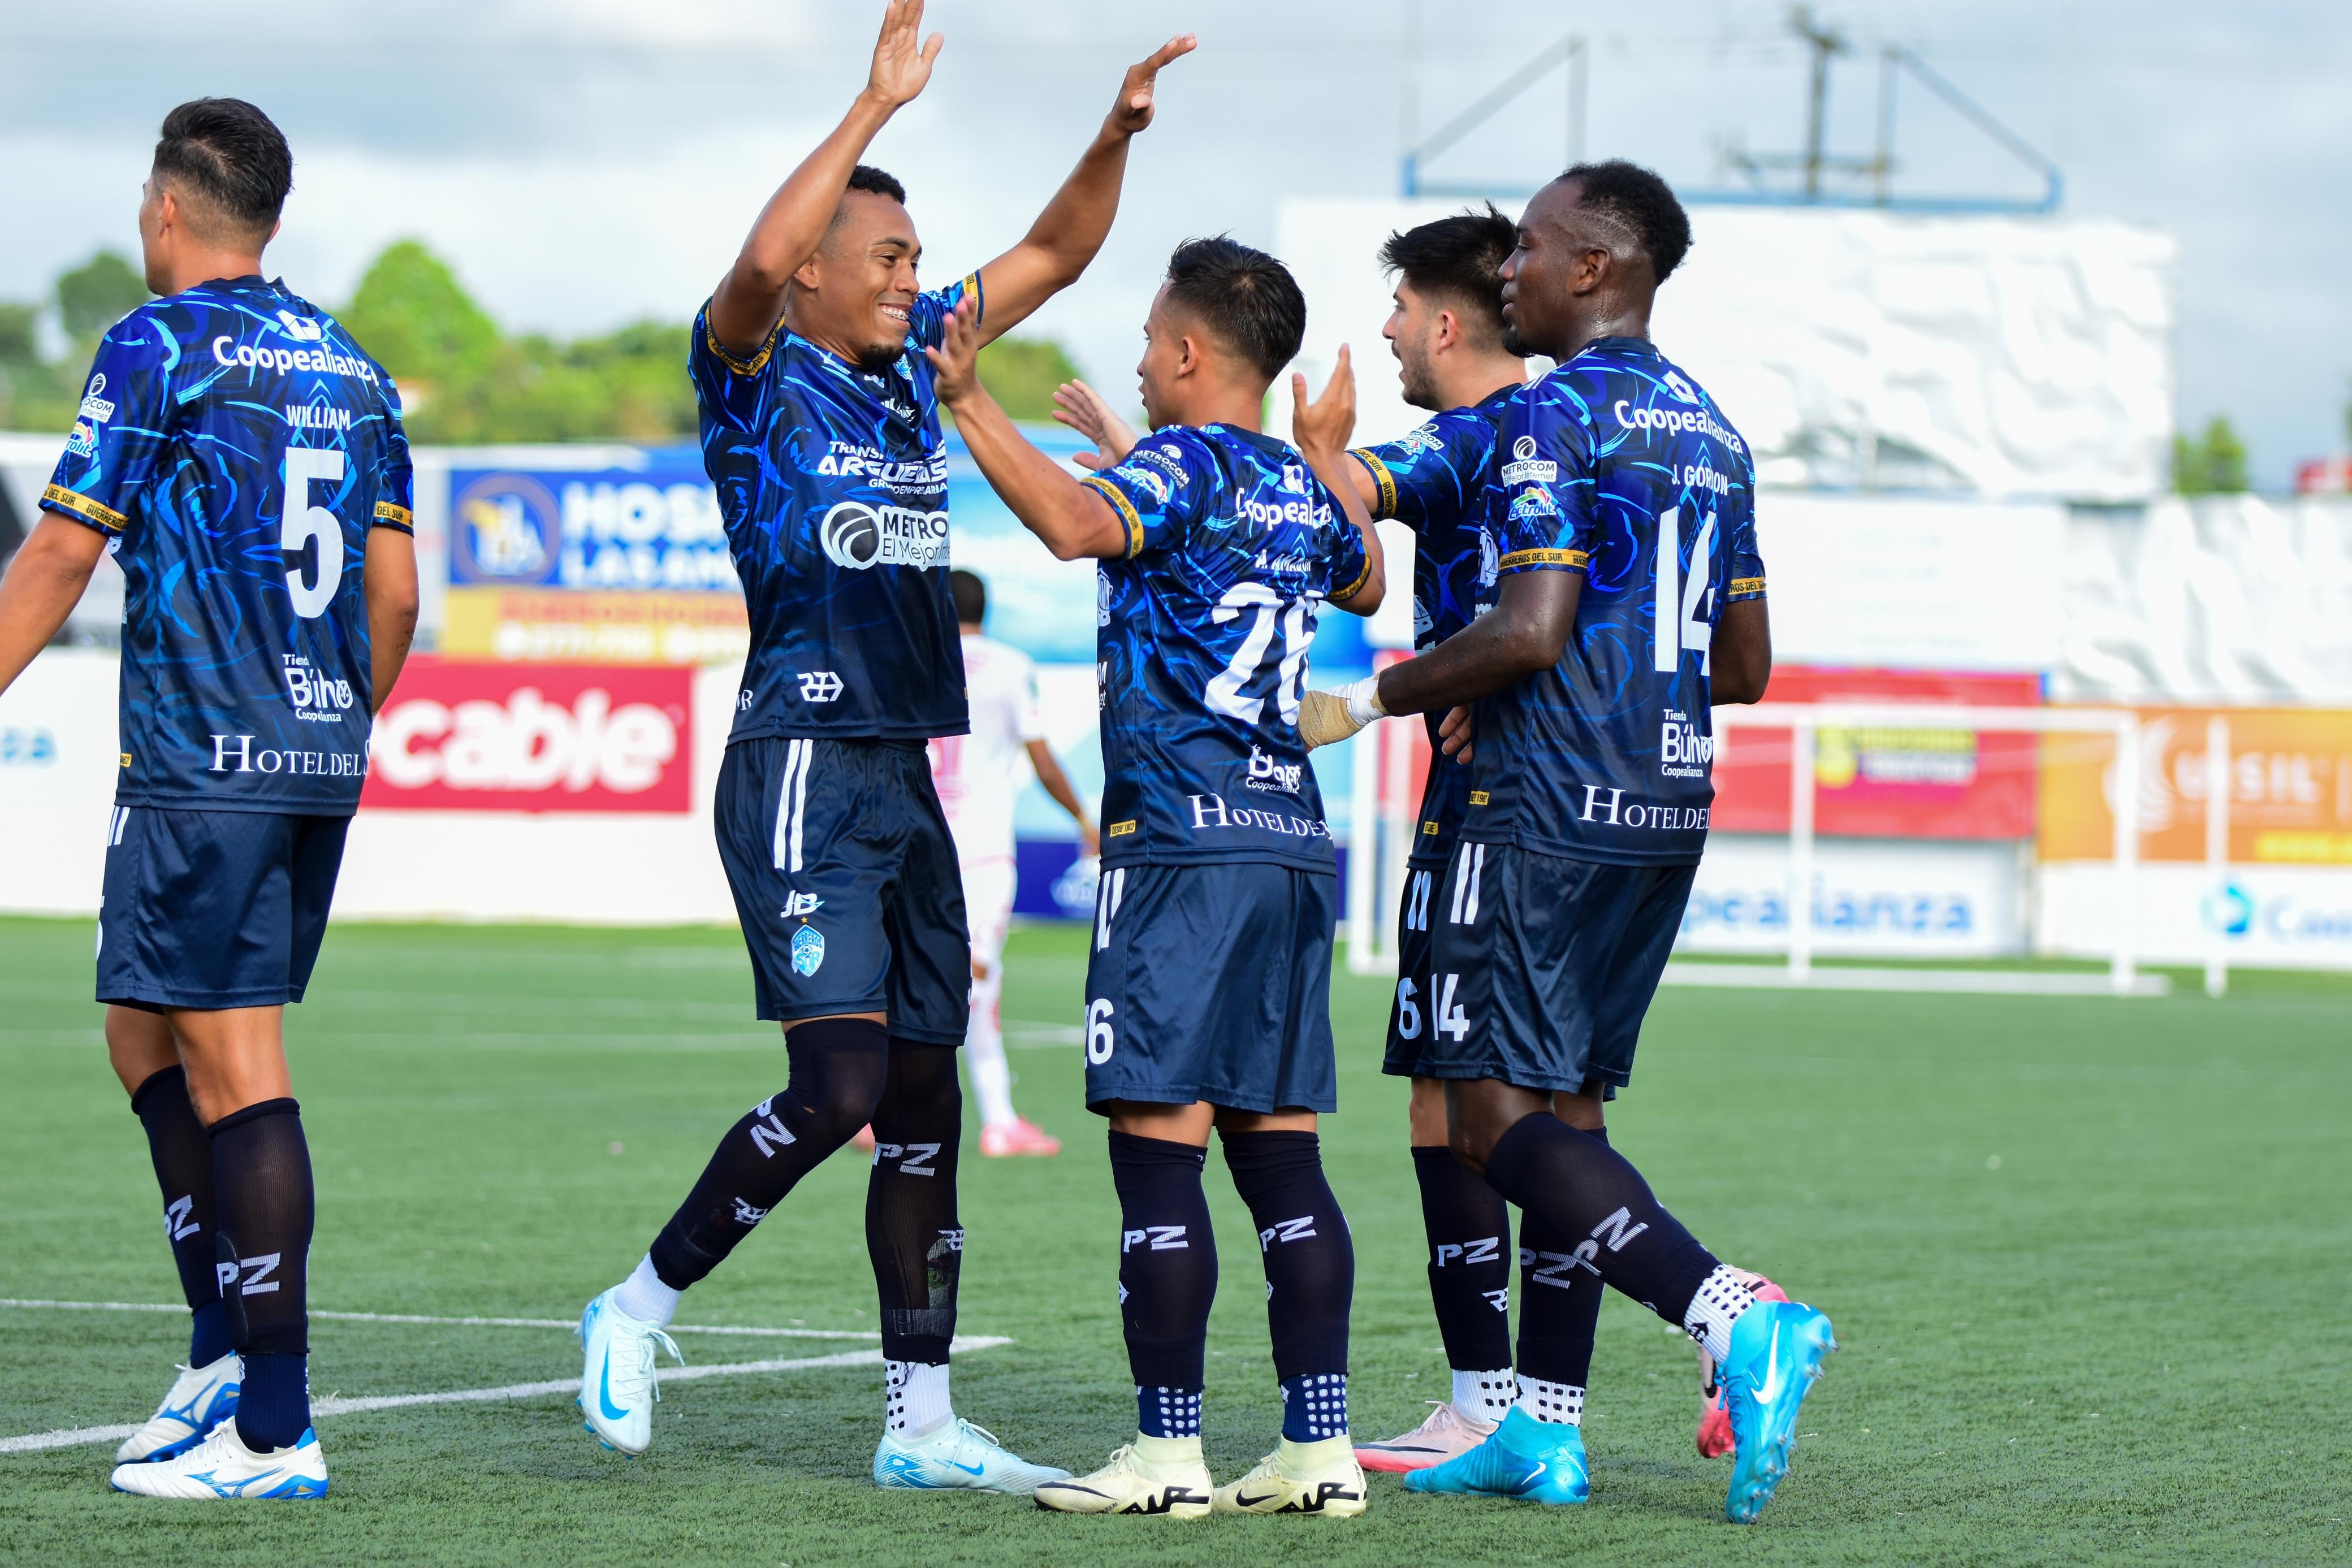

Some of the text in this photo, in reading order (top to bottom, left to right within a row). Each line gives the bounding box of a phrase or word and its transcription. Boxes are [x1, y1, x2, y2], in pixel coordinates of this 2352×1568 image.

[286, 405, 351, 431] WILLIAM
[1614, 399, 1744, 454] Coopealianza
[1134, 450, 1190, 484] METROCOM
[1369, 459, 1382, 472] SUR
[1503, 462, 1555, 477] METROCOM
[1525, 472, 1554, 480] Internet
[1671, 464, 1680, 485] J.
[60, 492, 76, 506] SUR
[377, 505, 391, 517] DEL
[282, 447, 344, 618] 5
[883, 538, 896, 557] El
[899, 540, 939, 565] Mejor
[1501, 552, 1563, 567] GUERREROS DEL SUR
[1654, 506, 1717, 677] 14
[1745, 581, 1758, 591] DEL
[1204, 582, 1324, 726] 26
[1663, 709, 1687, 721] Tienda
[1661, 722, 1713, 764] Búho
[330, 753, 365, 777] DEL
[1661, 764, 1704, 779] Coopealianza
[1577, 784, 1681, 829] HOTEL
[1431, 973, 1471, 1042] 14
[1084, 998, 1114, 1064] 6
[872, 1141, 941, 1177] PZ
[1123, 1225, 1188, 1253] PZ
[1260, 1215, 1317, 1252] PZ
[1572, 1206, 1649, 1277] PZ
[1437, 1236, 1499, 1267] PZ
[217, 1251, 281, 1298] PZ
